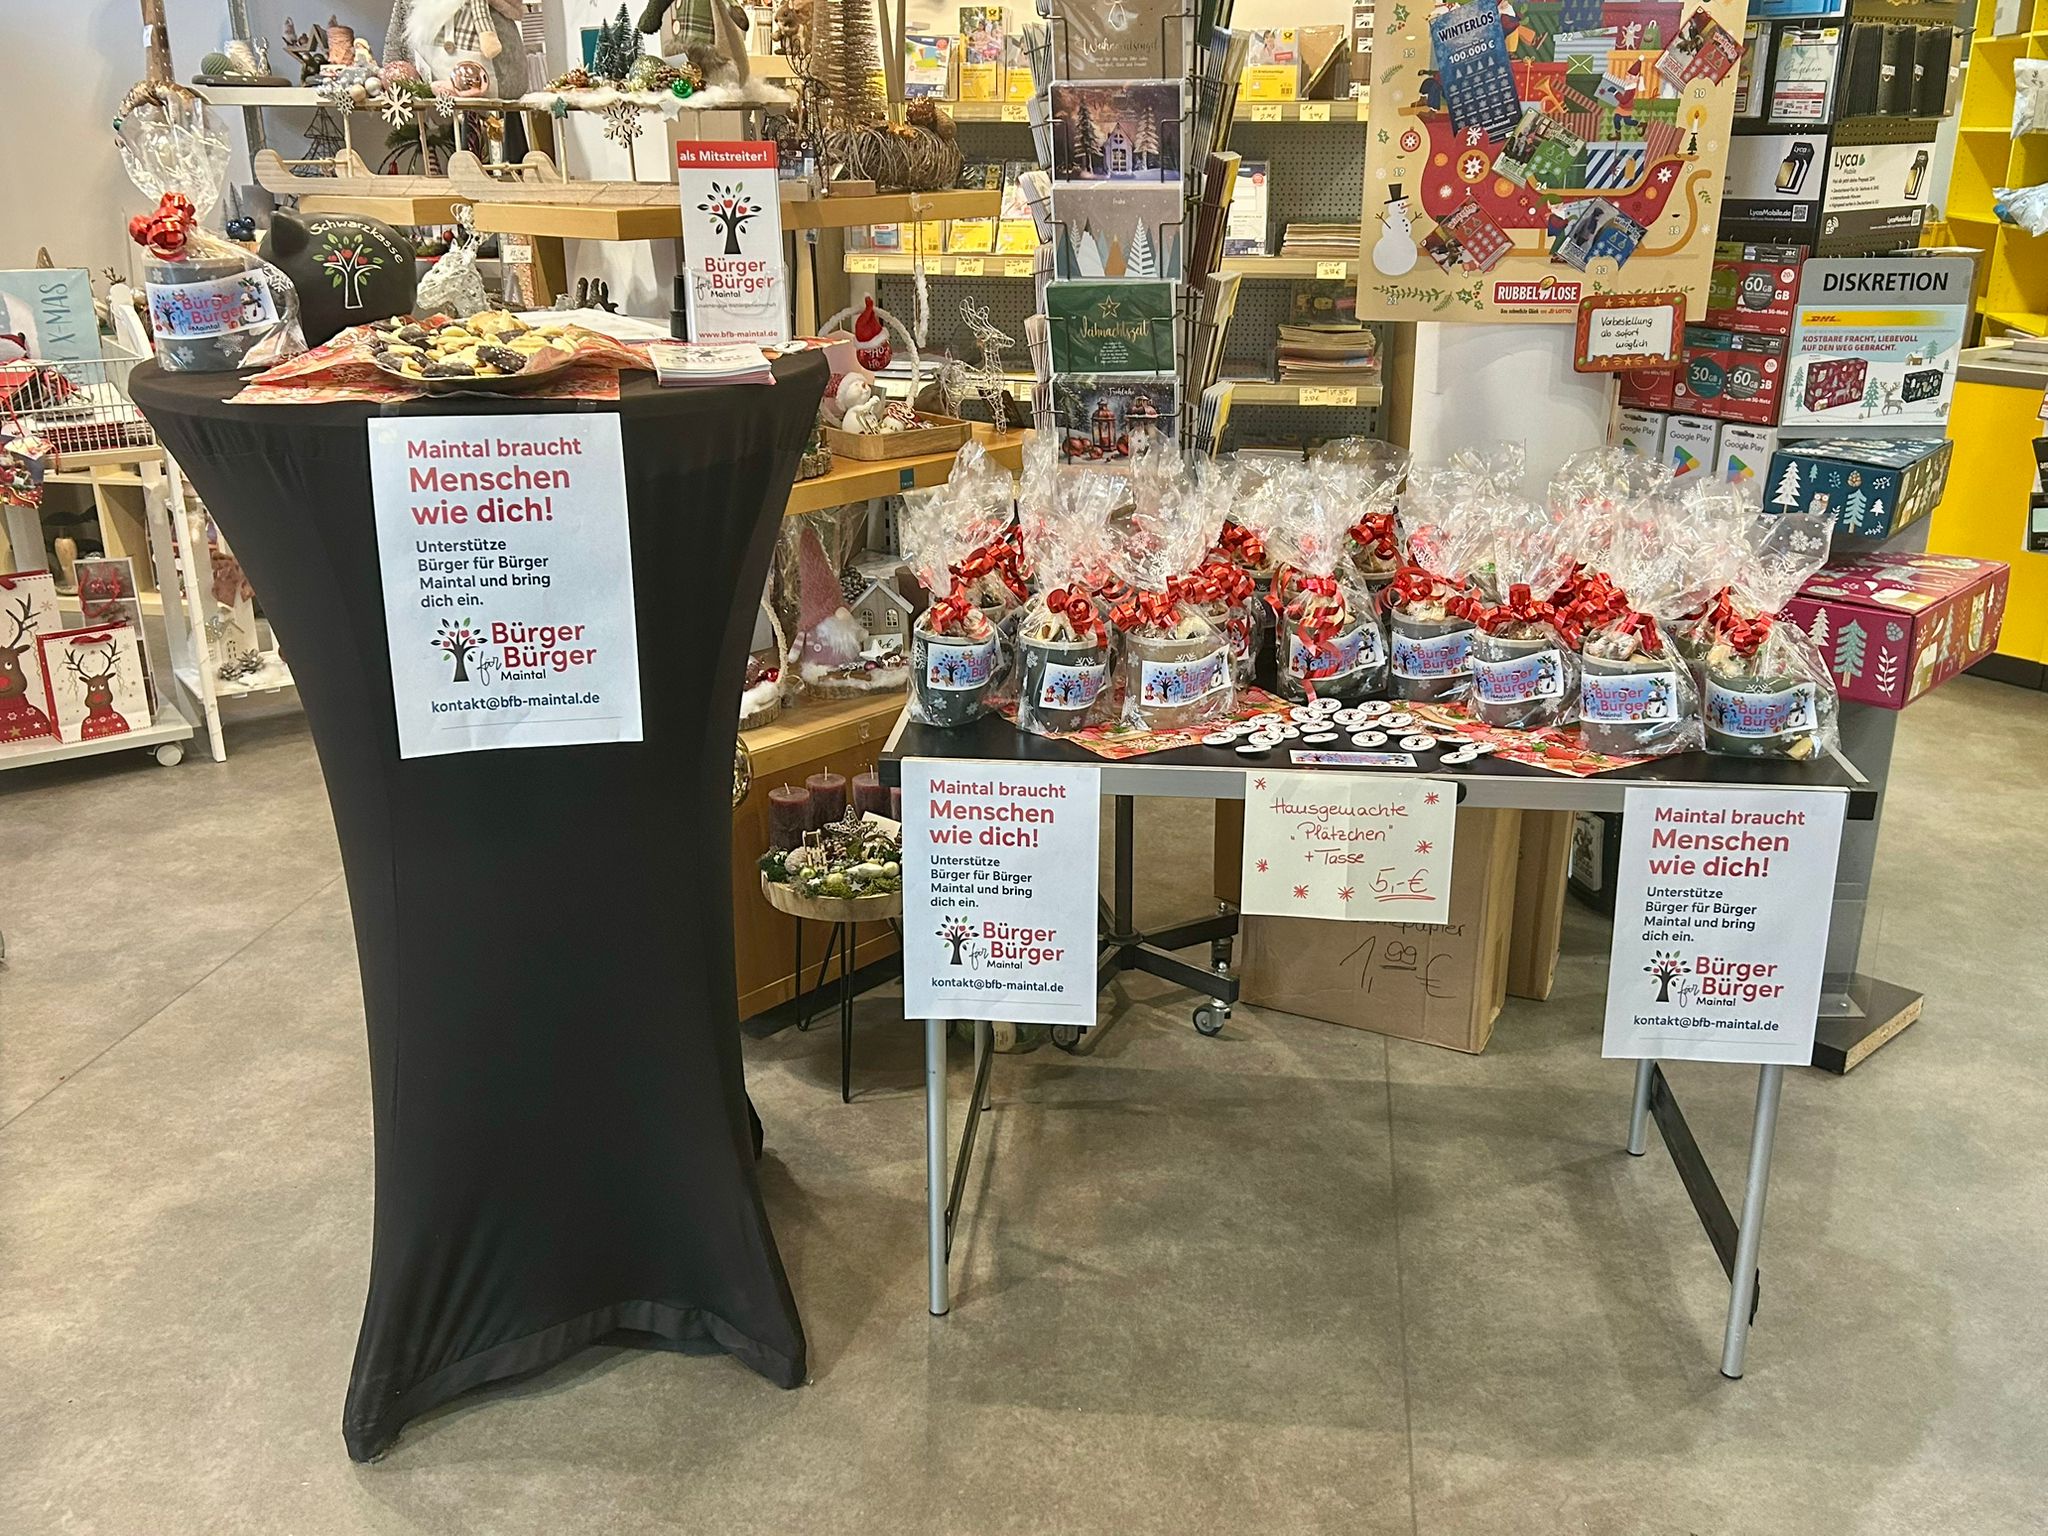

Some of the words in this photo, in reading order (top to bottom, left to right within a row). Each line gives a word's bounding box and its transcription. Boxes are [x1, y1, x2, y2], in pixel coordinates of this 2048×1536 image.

[1438, 12, 1494, 42] WINTERLOS
[1561, 32, 1574, 42] 22
[1402, 49, 1416, 59] 15
[1449, 43, 1488, 64] 100.000
[1694, 88, 1706, 98] 10
[1465, 137, 1478, 147] 14
[680, 150, 696, 161] als
[699, 150, 768, 162] Mitstreiter!
[1834, 152, 1859, 170] Lyca
[1393, 168, 1406, 177] 19
[1686, 164, 1693, 174] 9
[1535, 182, 1548, 191] 24
[1749, 208, 1792, 217] LycaMobile.de
[1669, 226, 1681, 236] 18
[309, 220, 404, 265] Schwarzkasse
[704, 257, 767, 276] Bürger
[1462, 270, 1469, 278] 4
[1596, 266, 1608, 275] 13
[712, 274, 774, 293] Bürger
[1822, 272, 1949, 292] DISKRETION
[710, 290, 741, 298] Maintal
[1498, 286, 1540, 300] RUBBEL
[1552, 286, 1577, 300] LOSE
[1774, 290, 1790, 301] GB
[182, 293, 236, 312] Bürger
[1387, 297, 1399, 306] 21
[38, 283, 76, 344] X-MAS
[190, 304, 244, 325] Bürger
[192, 323, 221, 332] Maintal
[1600, 316, 1654, 328] Vorbestellung
[698, 330, 778, 339] www.bfb-maintal.de
[1614, 328, 1640, 339] sofort
[1844, 335, 1877, 344] FRACHT,
[1877, 334, 1919, 342] LIEBEVOLL
[1619, 423, 1642, 435] Google
[1642, 426, 1656, 436] Play
[1670, 430, 1694, 442] Google
[1696, 434, 1711, 444] Play
[407, 438, 490, 459] Maintal
[496, 437, 582, 457] braucht
[1724, 439, 1750, 451] Google
[1750, 442, 1765, 453] Play
[409, 465, 570, 492] Menschen
[411, 499, 468, 525] wie
[476, 496, 554, 523] dich!
[416, 538, 507, 553] Unterstütze
[418, 558, 470, 574] Bürger
[473, 556, 494, 570] für
[498, 556, 549, 571] Bürger
[419, 576, 476, 590] Maintal
[480, 574, 509, 587] und
[512, 573, 551, 588] bring
[420, 594, 453, 608] dich
[457, 594, 484, 606] ein.
[491, 622, 586, 649] Bürger
[1417, 644, 1461, 660] Bürger
[476, 650, 502, 686] für
[504, 646, 598, 672] Bürger
[1423, 655, 1468, 671] Bürger
[500, 670, 546, 682] Maintal
[1488, 669, 1534, 685] Bürger
[1494, 679, 1540, 695] Bürger
[1594, 687, 1644, 702] Bürger
[431, 692, 600, 714] kontakt@bfb-maintal.de
[1600, 699, 1650, 715] Bürger
[1738, 702, 1787, 718] Bürger
[1743, 714, 1791, 729] Bürger
[930, 779, 994, 796] Maintal
[999, 782, 1066, 798] braucht
[930, 800, 1054, 824] Menschen
[1270, 797, 1408, 822] Hausgemachte
[1655, 806, 1726, 824] Maintal
[1731, 810, 1806, 826] braucht
[930, 824, 973, 845] wie
[978, 826, 1039, 848] dich!
[1652, 828, 1790, 852] Menschen
[930, 854, 1000, 867] Unterstütze
[1304, 851, 1314, 862] +
[1314, 848, 1365, 865] Tasse
[1648, 854, 1696, 876] wie
[1702, 856, 1770, 878] dich!
[930, 869, 970, 882] Bürger
[973, 870, 990, 880] für
[992, 870, 1032, 884] Bürger
[930, 882, 974, 894] Maintal
[977, 884, 999, 894] und
[1002, 885, 1033, 898] bring
[1646, 886, 1724, 899] Unterstütze
[930, 897, 956, 907] dich
[958, 898, 979, 908] ein.
[1645, 901, 1688, 915] Bürger
[1692, 902, 1710, 913] für
[1713, 902, 1758, 917] Bürger
[1644, 916, 1692, 928] Maintal
[1694, 918, 1718, 928] und
[1721, 918, 1756, 932] bring
[983, 921, 1057, 946] Bürger
[1642, 930, 1668, 941] dich
[1671, 932, 1694, 942] ein.
[968, 942, 989, 971] für
[990, 940, 1064, 965] Bürger
[986, 960, 1023, 970] Maintal
[1696, 956, 1778, 982] Bürger
[1415, 954, 1456, 998] €
[931, 978, 1064, 992] kontakt@bfb-maintal.de
[1677, 978, 1700, 1008] für
[1702, 976, 1784, 1002] Bürger
[1696, 996, 1736, 1006] Maintal
[1634, 1015, 1779, 1031] kontakt@bfb-maintal.de
